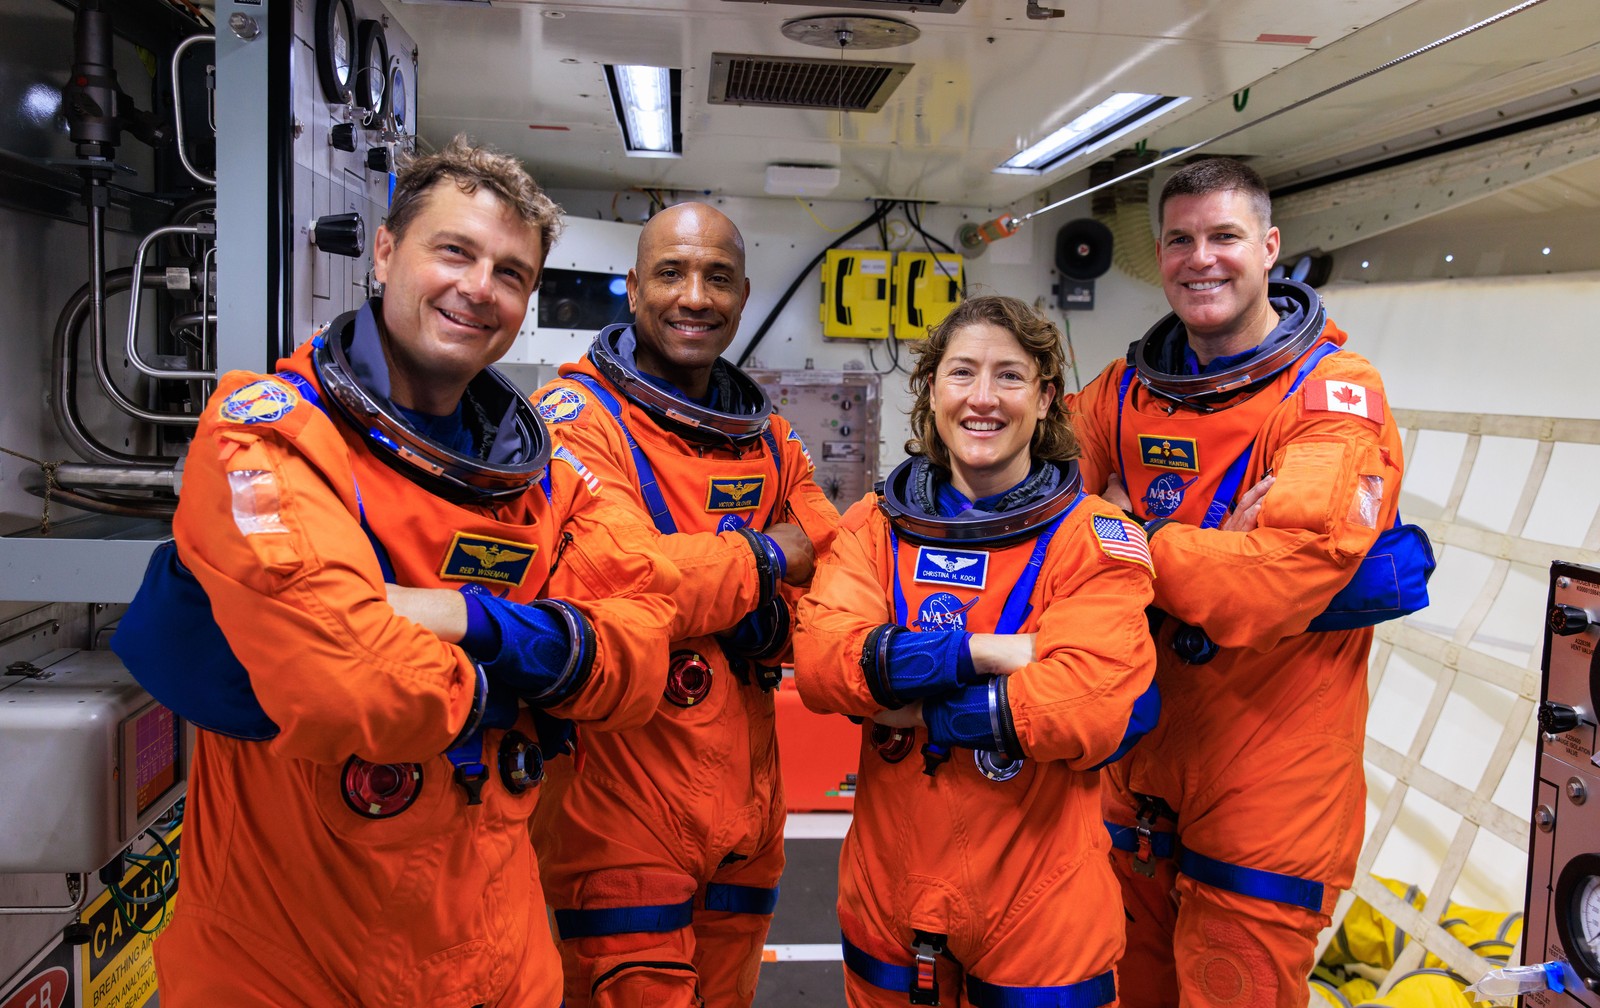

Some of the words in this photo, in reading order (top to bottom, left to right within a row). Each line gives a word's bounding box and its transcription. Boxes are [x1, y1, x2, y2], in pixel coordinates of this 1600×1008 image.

[1149, 457, 1166, 465] JEREMY
[1168, 460, 1189, 468] HANSEN
[1149, 487, 1181, 502] NASA
[459, 566, 475, 574] REID
[477, 568, 510, 580] WISEMAN
[922, 570, 950, 579] CHRISTINA
[921, 610, 963, 625] NASA
[1571, 643, 1581, 651] VENT
[1566, 747, 1578, 757] VALVE
[1570, 742, 1590, 755] ISOLATION
[93, 947, 140, 1007] BREATHING
[140, 932, 154, 953] AIR
[120, 956, 152, 998] ANALYZER
